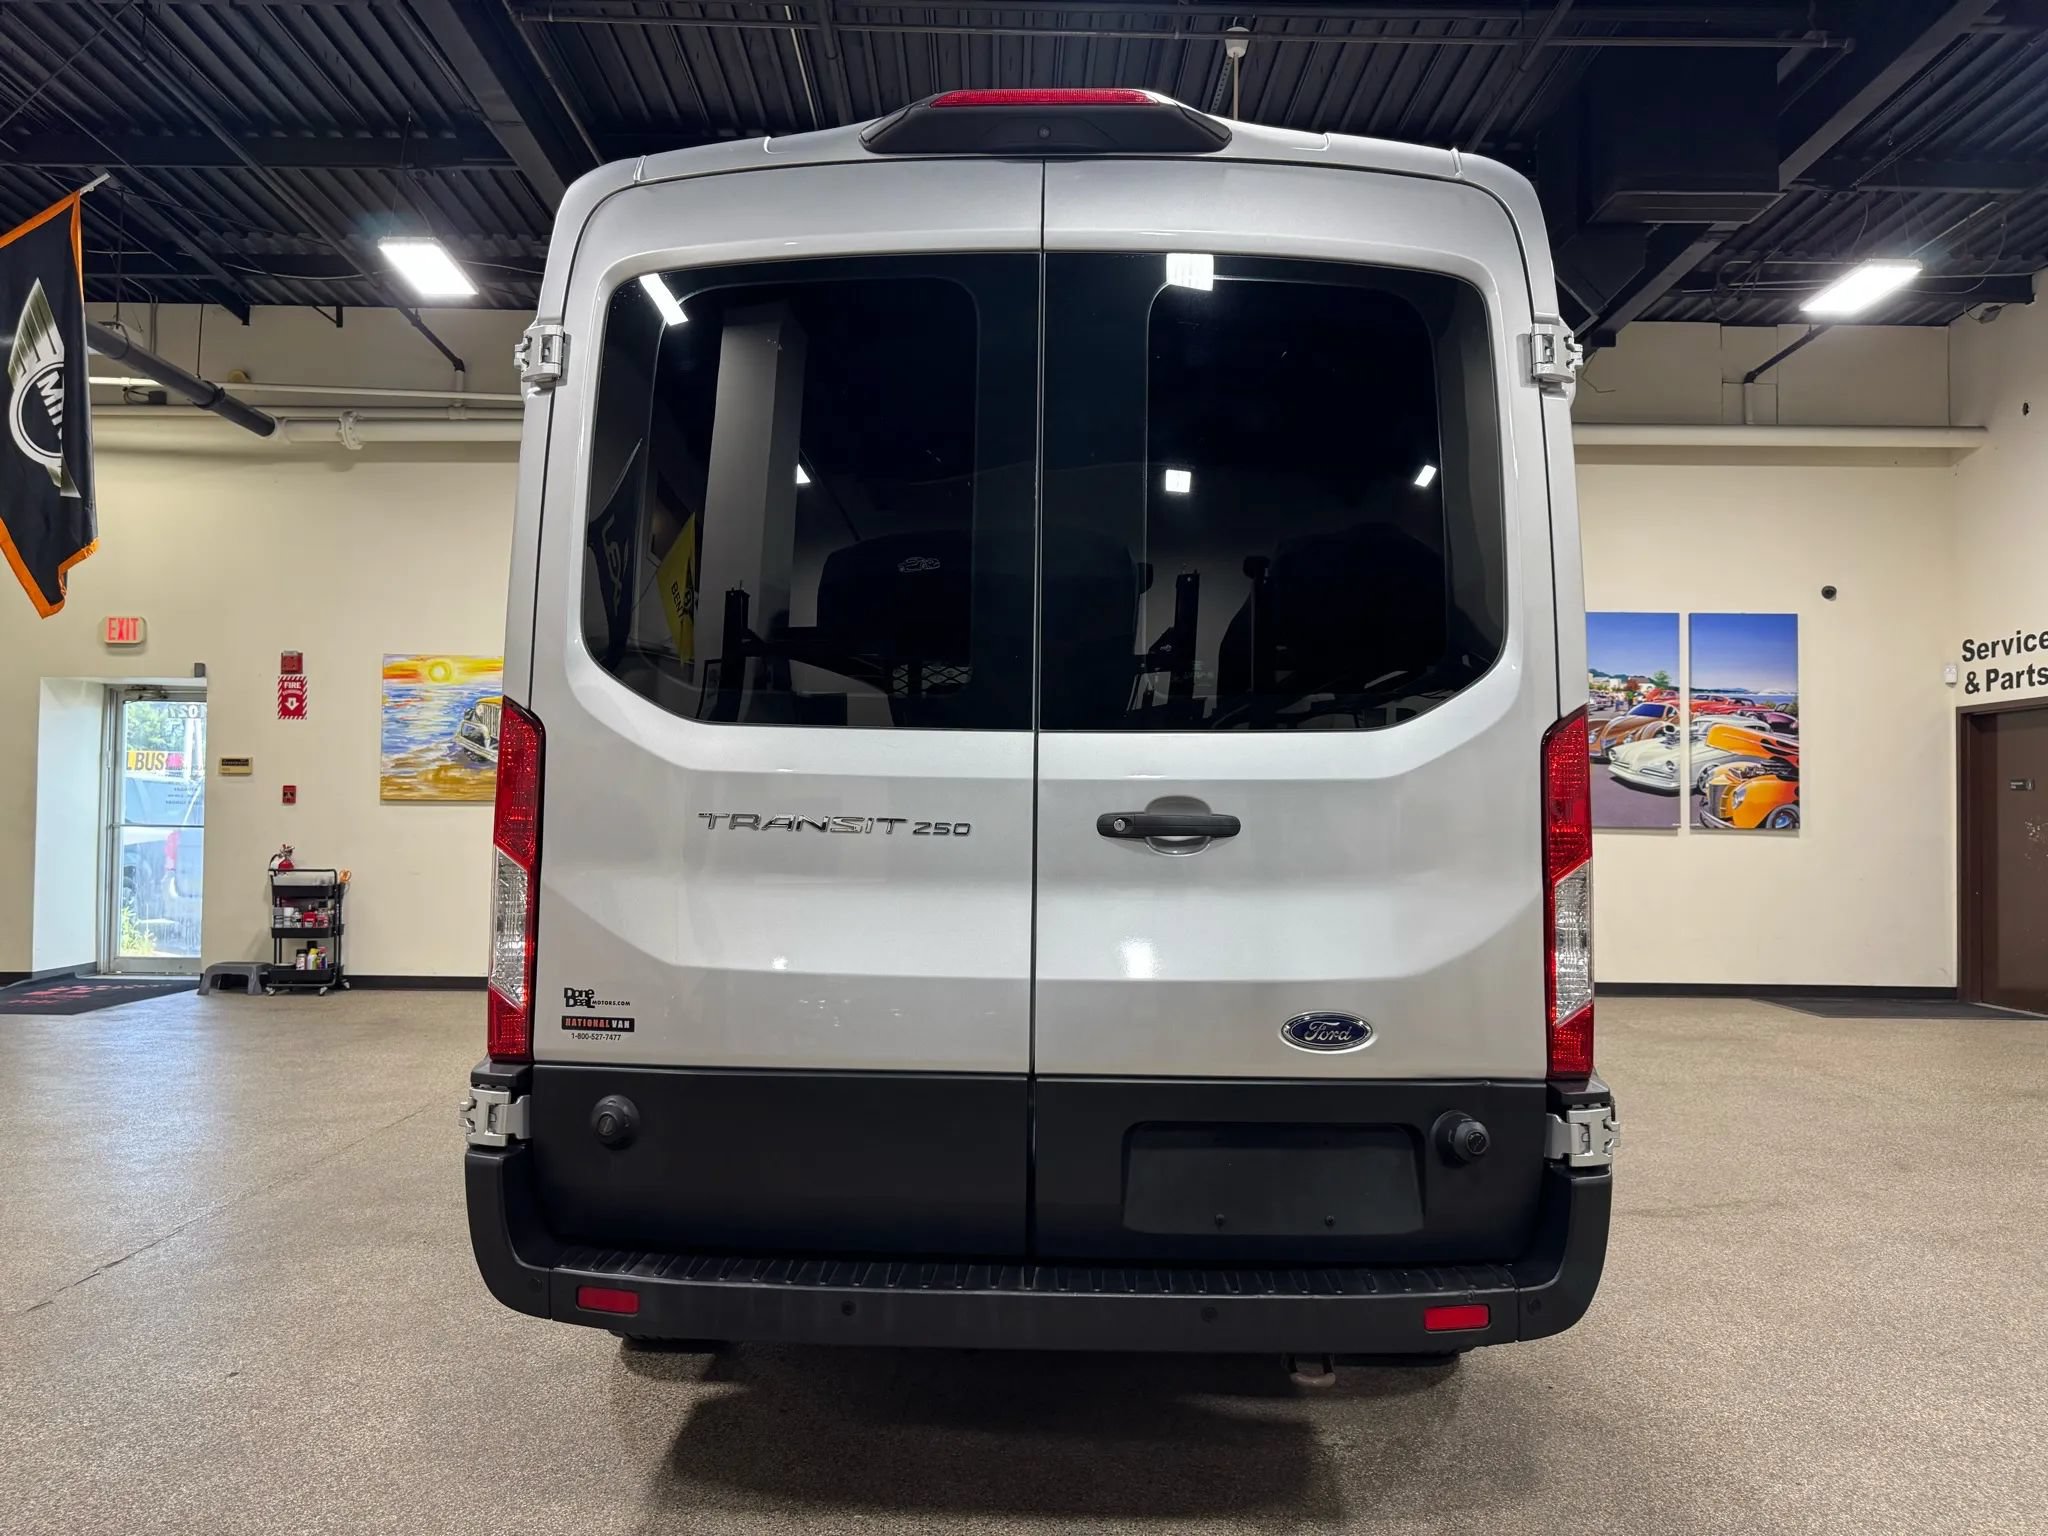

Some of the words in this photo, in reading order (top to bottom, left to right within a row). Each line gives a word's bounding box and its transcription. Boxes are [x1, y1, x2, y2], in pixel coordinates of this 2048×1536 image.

[107, 617, 138, 641] EXIT
[1961, 630, 2048, 662] Service
[284, 681, 302, 689] FIRE
[1964, 671, 1980, 694] &
[1985, 663, 2048, 692] Parts
[135, 752, 165, 771] BUS
[698, 812, 908, 834] TRANSIT
[912, 821, 971, 836] 250
[564, 987, 595, 999] Done
[565, 1018, 610, 1028] NATIONAL
[611, 1020, 630, 1029] VAN
[1304, 1021, 1353, 1041] Ford
[571, 1032, 621, 1041] 1-800-527-7477
